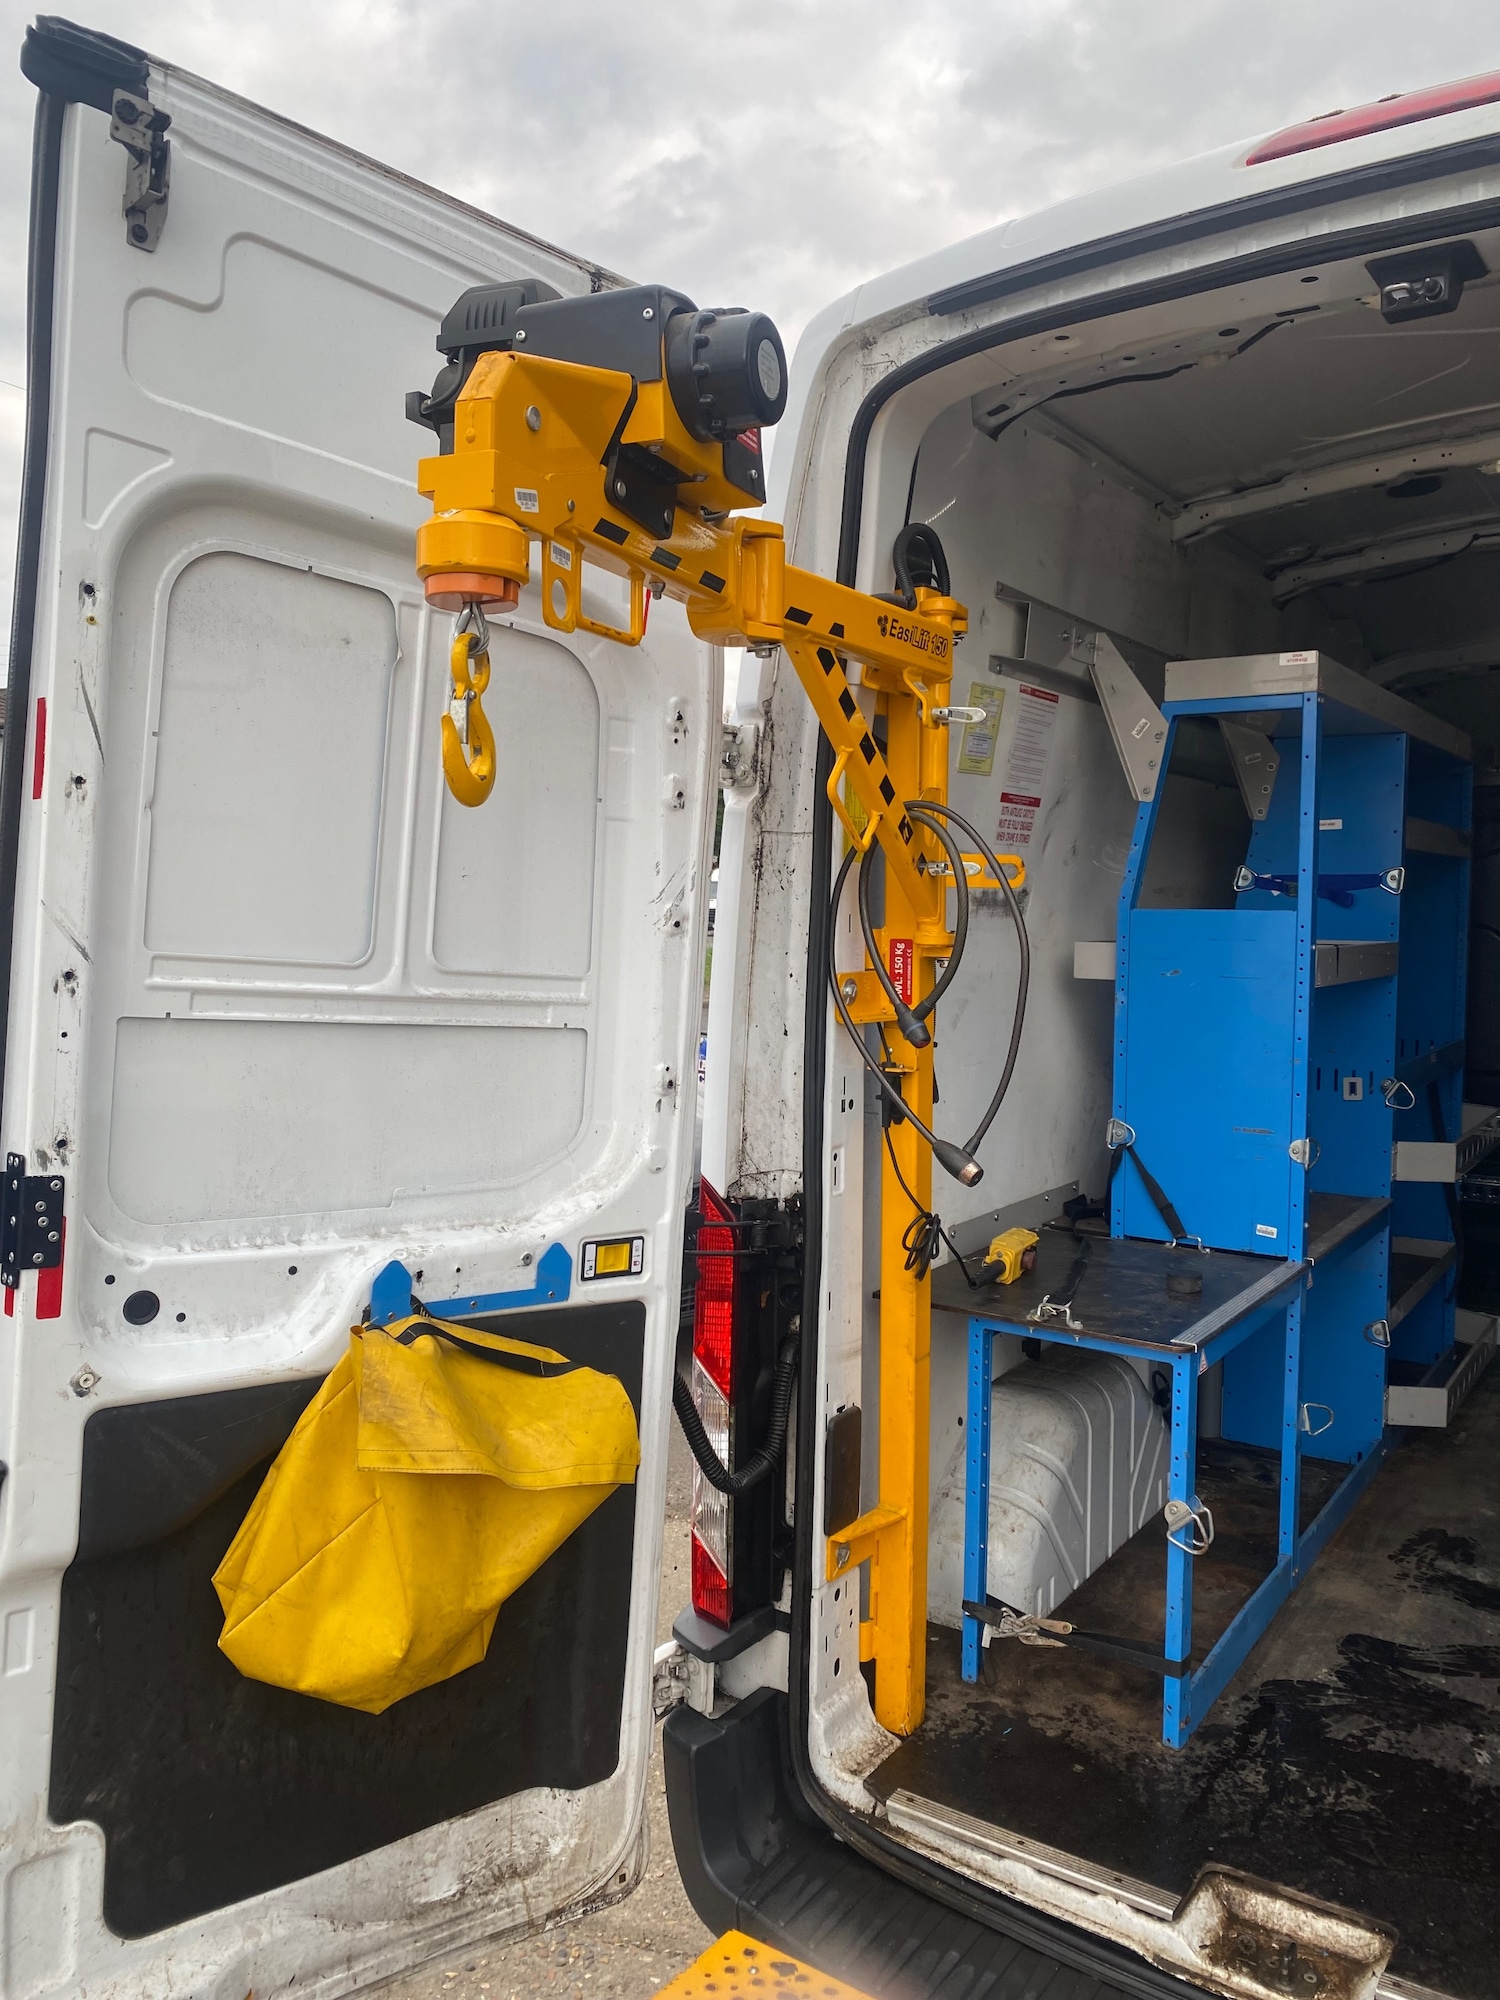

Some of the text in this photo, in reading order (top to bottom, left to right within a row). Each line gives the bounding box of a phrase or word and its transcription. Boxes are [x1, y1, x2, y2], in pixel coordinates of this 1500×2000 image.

[889, 618, 948, 657] EasiLift 150
[894, 942, 905, 955] Kg
[894, 956, 903, 974] 150
